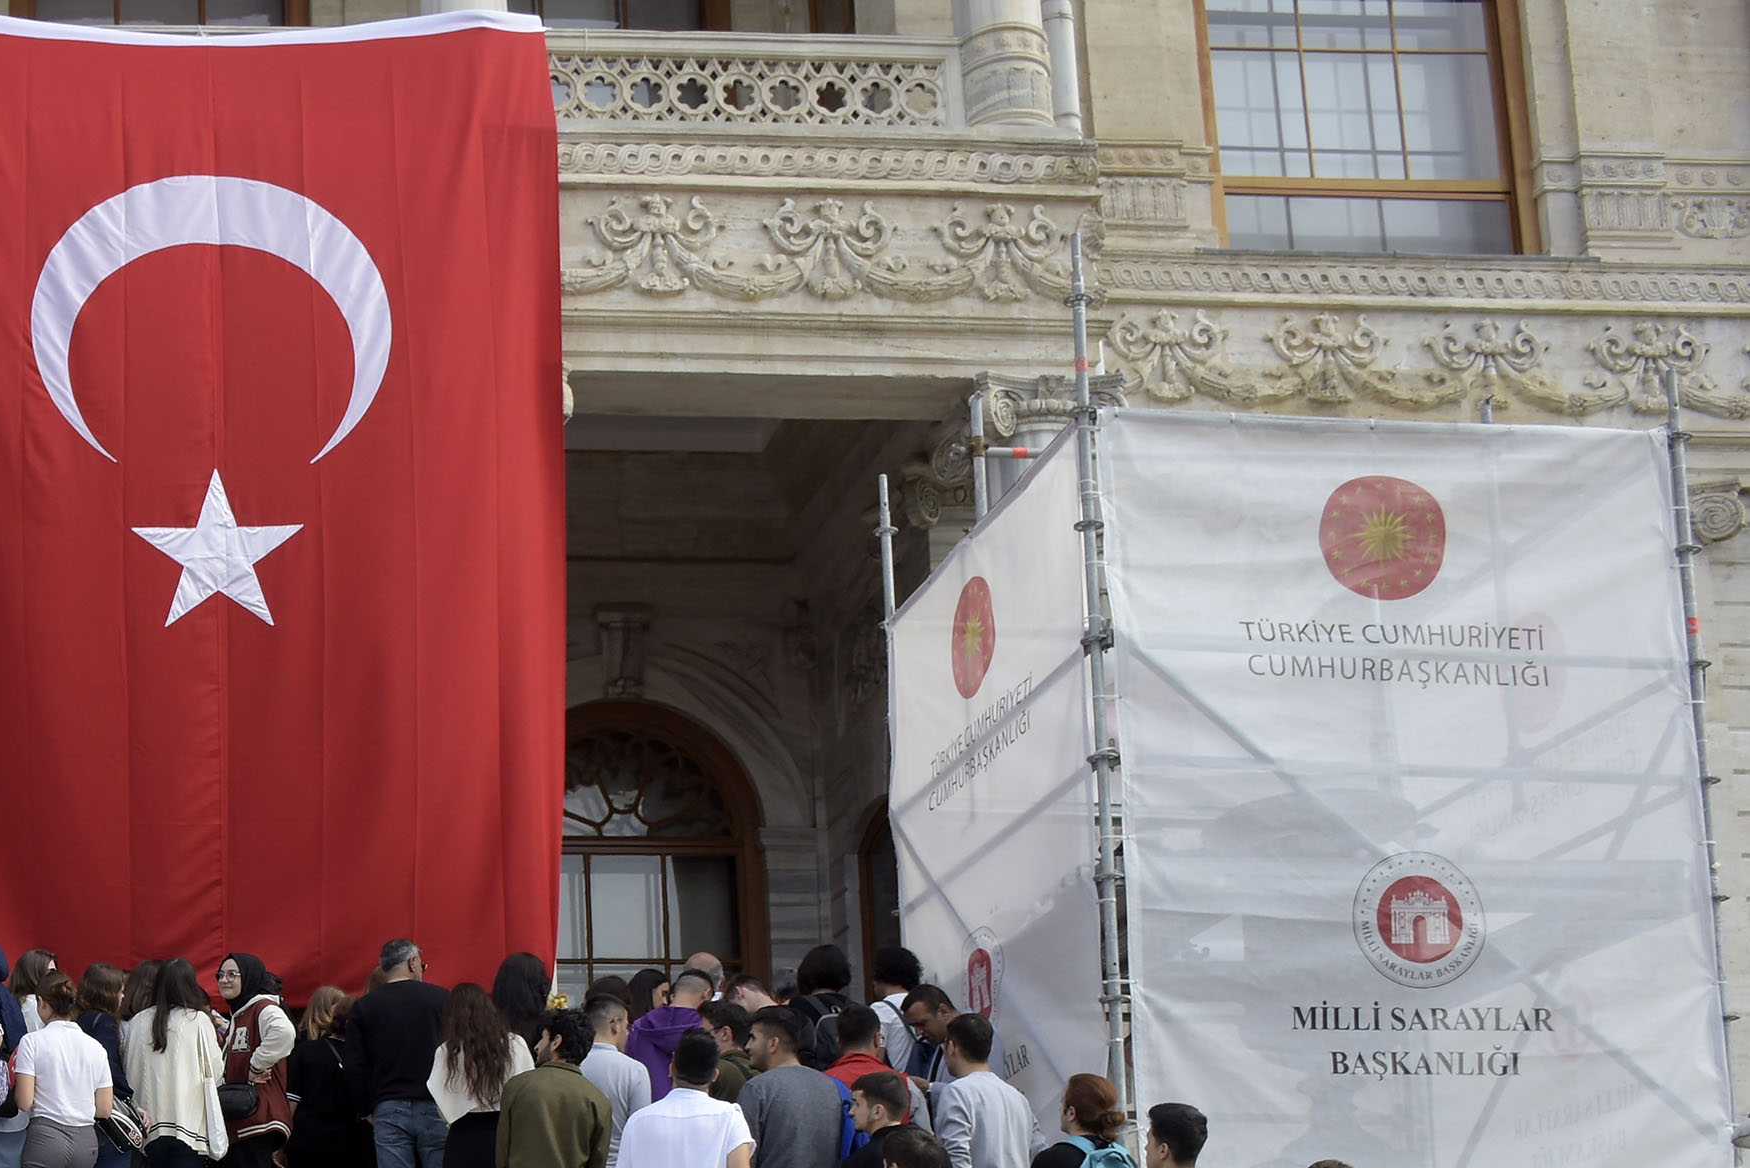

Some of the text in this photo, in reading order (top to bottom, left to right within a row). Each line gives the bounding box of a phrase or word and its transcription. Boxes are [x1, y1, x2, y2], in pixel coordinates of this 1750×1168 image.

[1238, 617, 1545, 652] TÜRKİYE CUMHURİYETİ
[1247, 655, 1550, 690] CUMHURBAŞKANLIĞI
[928, 709, 1031, 812] CUMHURBAŞKANLIĞI
[1291, 1000, 1556, 1033] MİLLİ SARAYLAR
[1328, 1045, 1523, 1083] BAŞKANLIĞI
